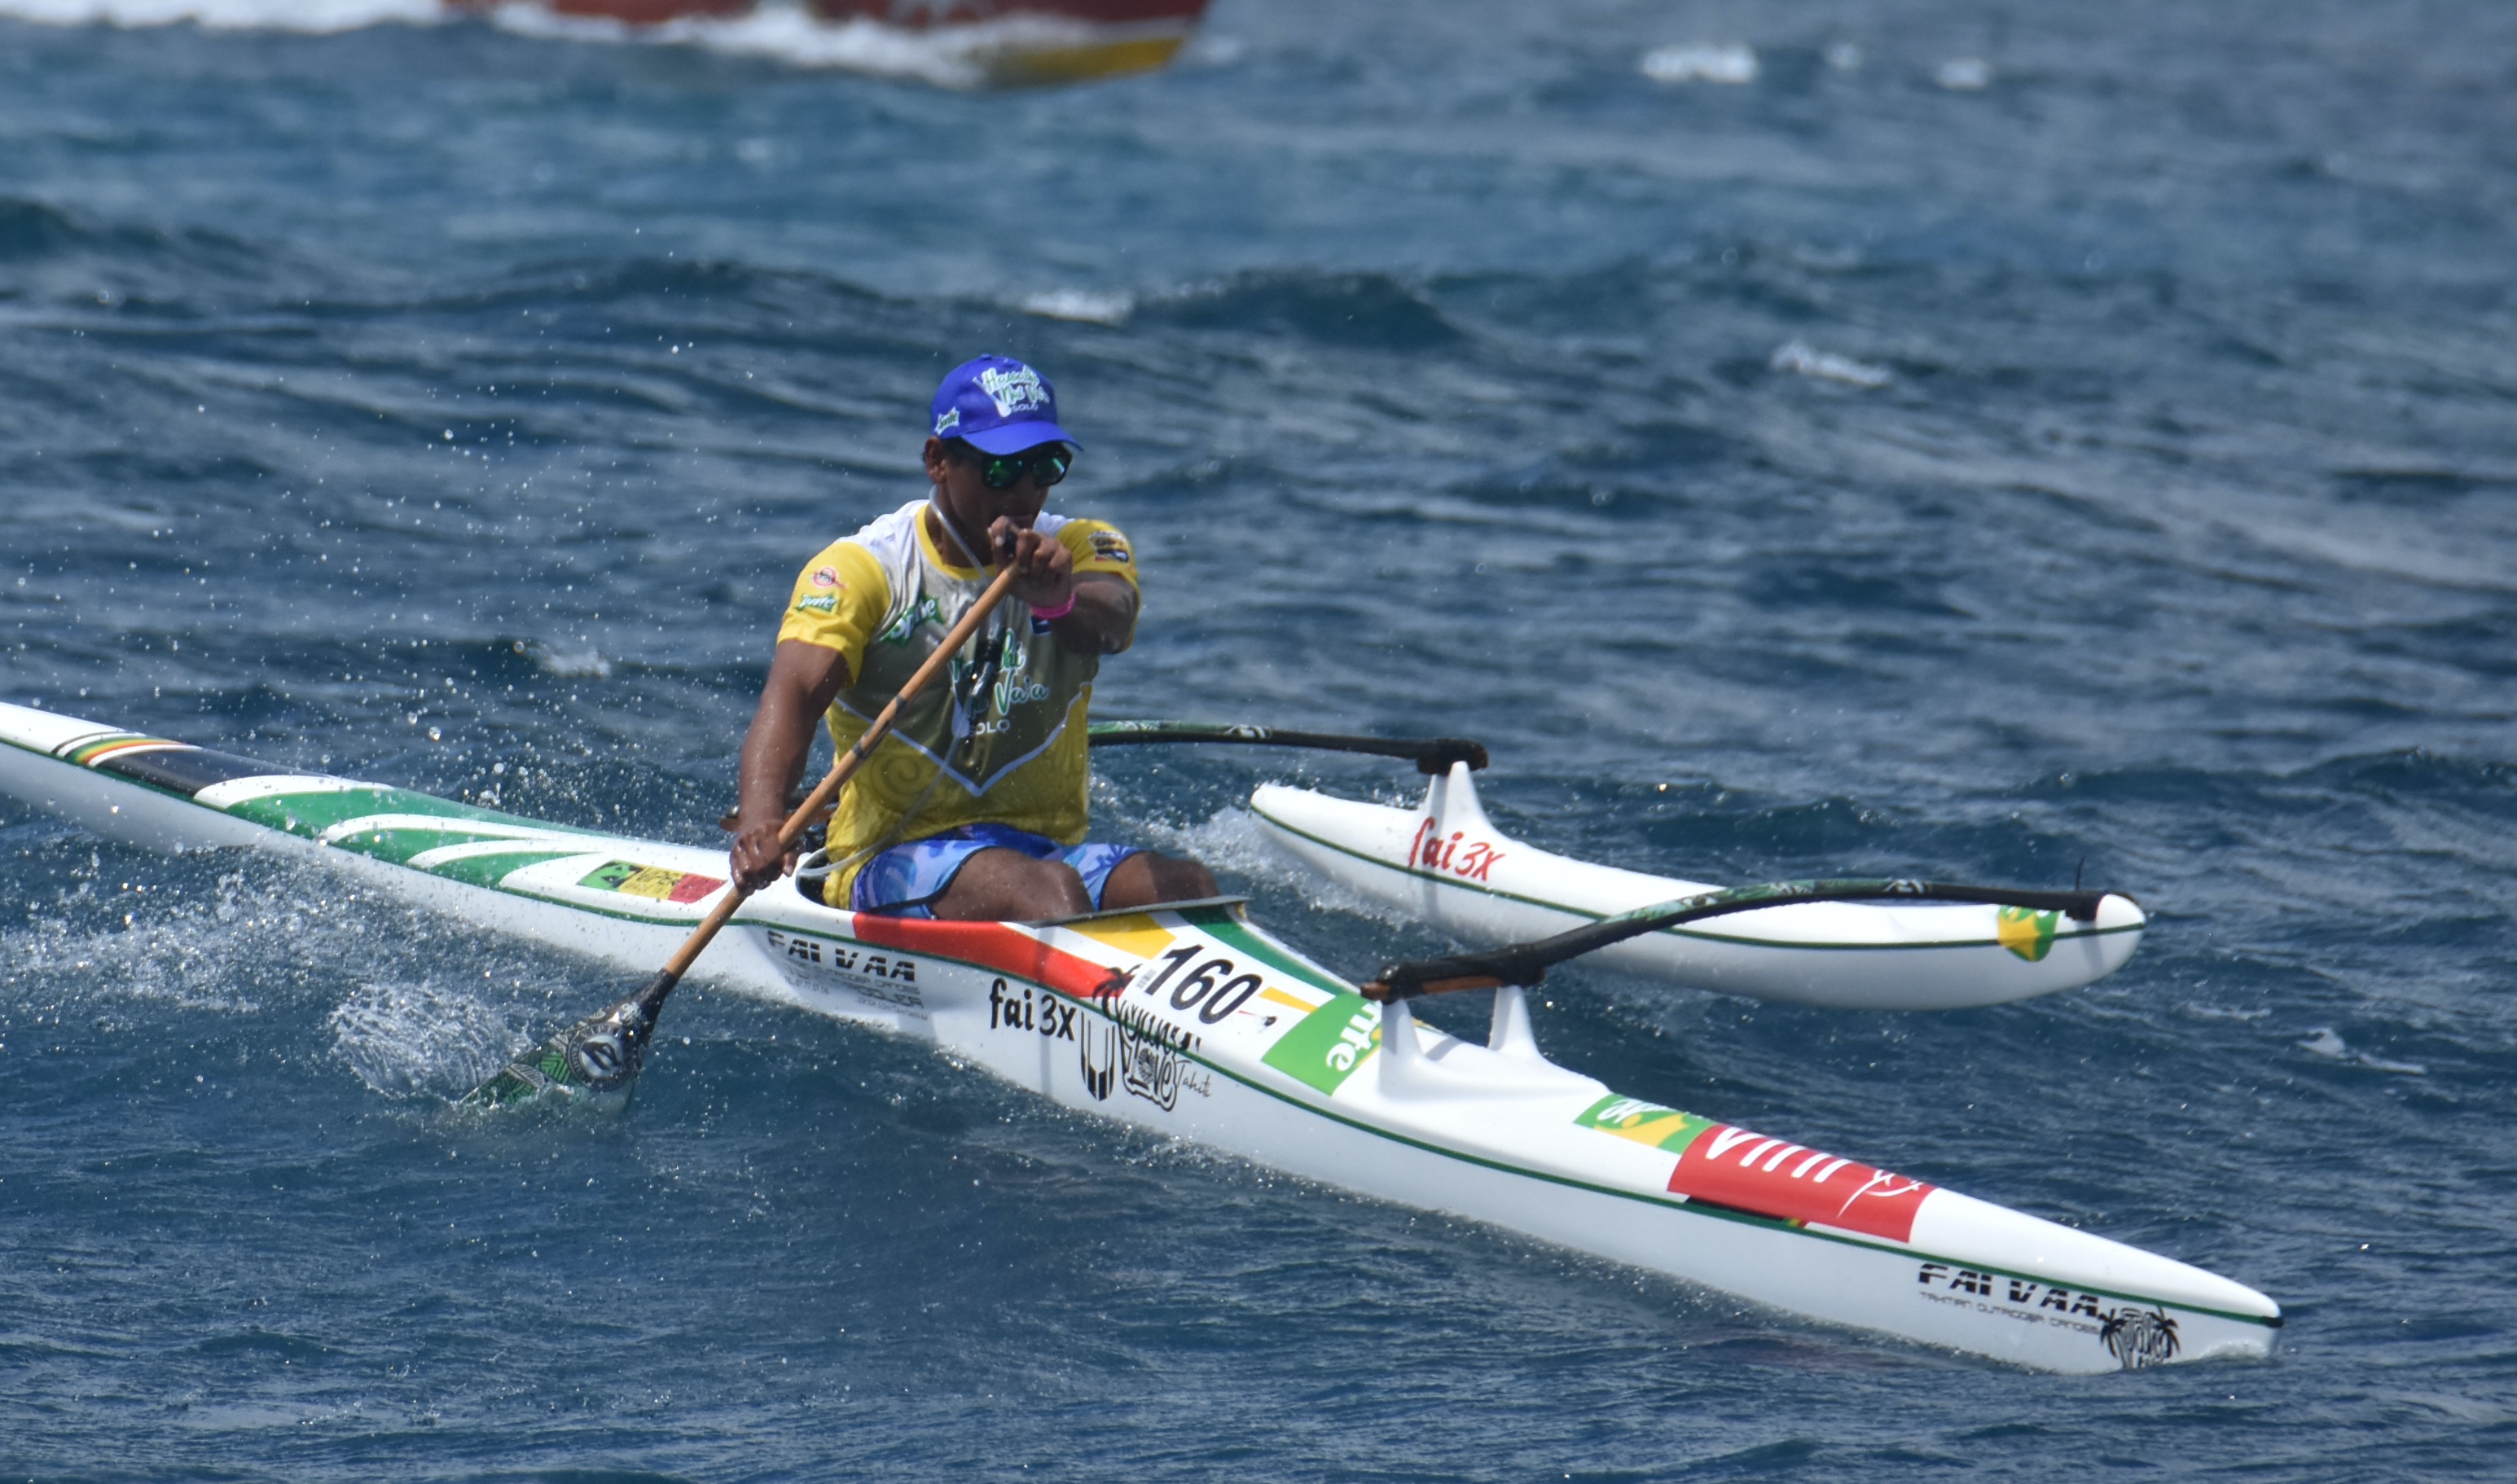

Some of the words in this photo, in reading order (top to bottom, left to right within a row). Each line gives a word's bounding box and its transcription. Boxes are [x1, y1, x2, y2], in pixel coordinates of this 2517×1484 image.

[995, 670, 1049, 715] Va'a
[1408, 816, 1465, 868] fai
[767, 930, 821, 963] FAI
[835, 948, 916, 981] VAA
[989, 977, 1034, 1030] fai
[1039, 994, 1076, 1042] 3x
[1144, 944, 1263, 1025] 160
[1918, 1262, 1992, 1297] FAI
[2009, 1280, 2101, 1317] VAA
